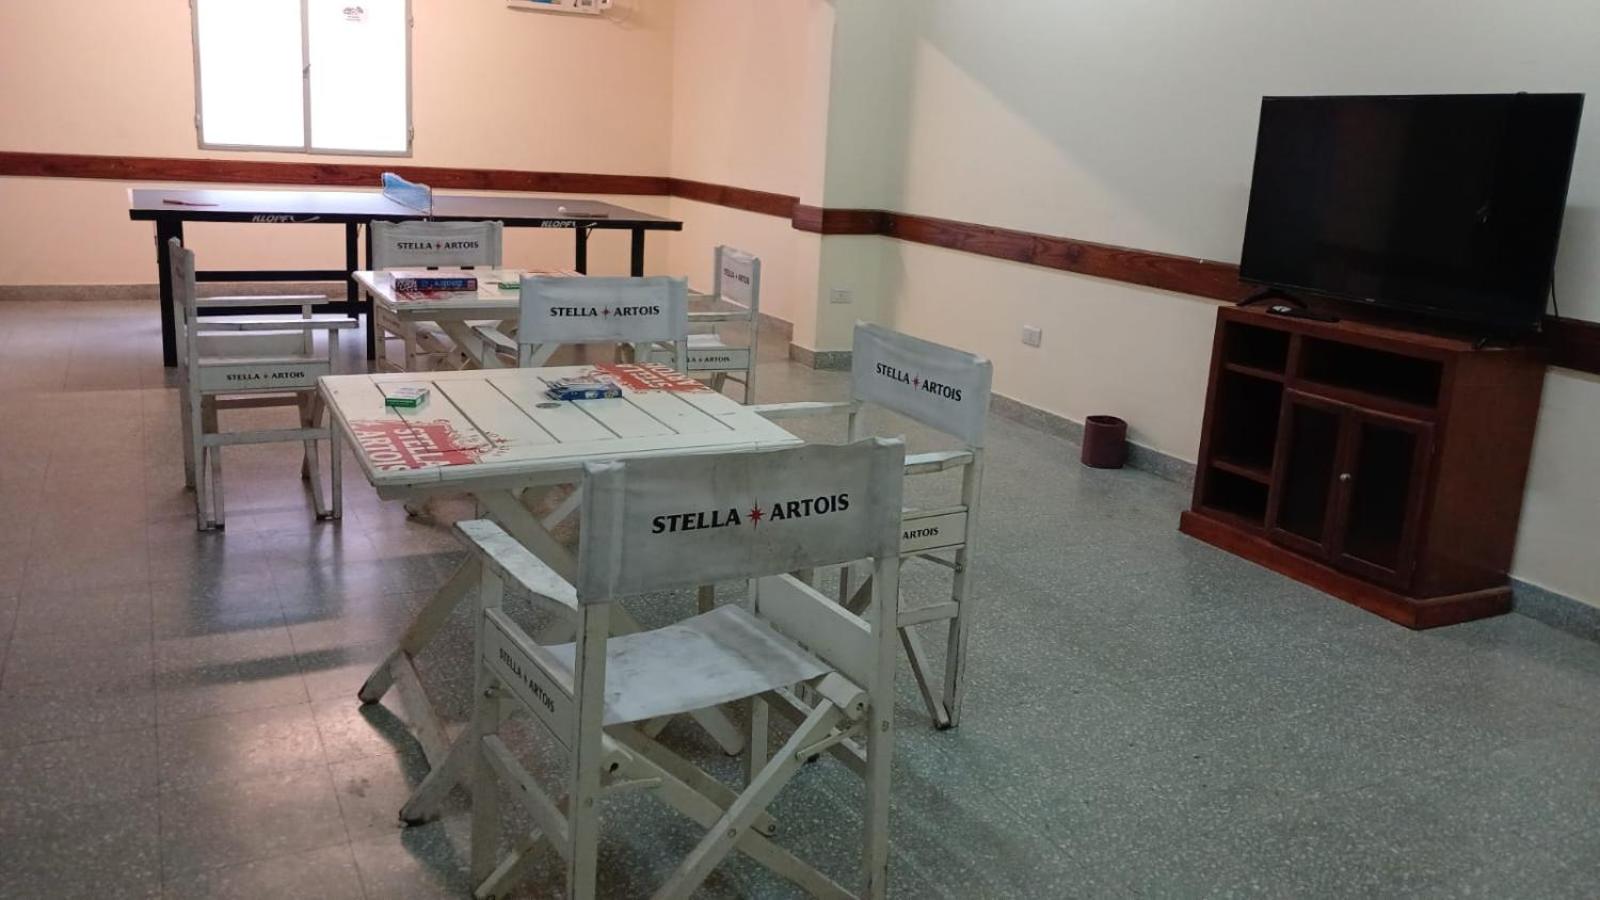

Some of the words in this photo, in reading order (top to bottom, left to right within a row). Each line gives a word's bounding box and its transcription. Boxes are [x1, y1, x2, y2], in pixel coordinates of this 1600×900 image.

[397, 241, 433, 250] STELLA
[444, 240, 479, 249] ARTOIS
[550, 307, 598, 317] STELLA
[614, 306, 660, 317] ARTOIS
[226, 373, 260, 381] STELLA
[271, 371, 305, 379] ARTOIS
[876, 362, 910, 385] STELLA
[922, 379, 962, 402] ARTOIS
[652, 508, 742, 535] STELLA
[769, 493, 850, 521] ARTOIS
[903, 527, 939, 539] ARTOIS
[500, 648, 521, 678] STELLA
[529, 680, 555, 713] ARTOIS
